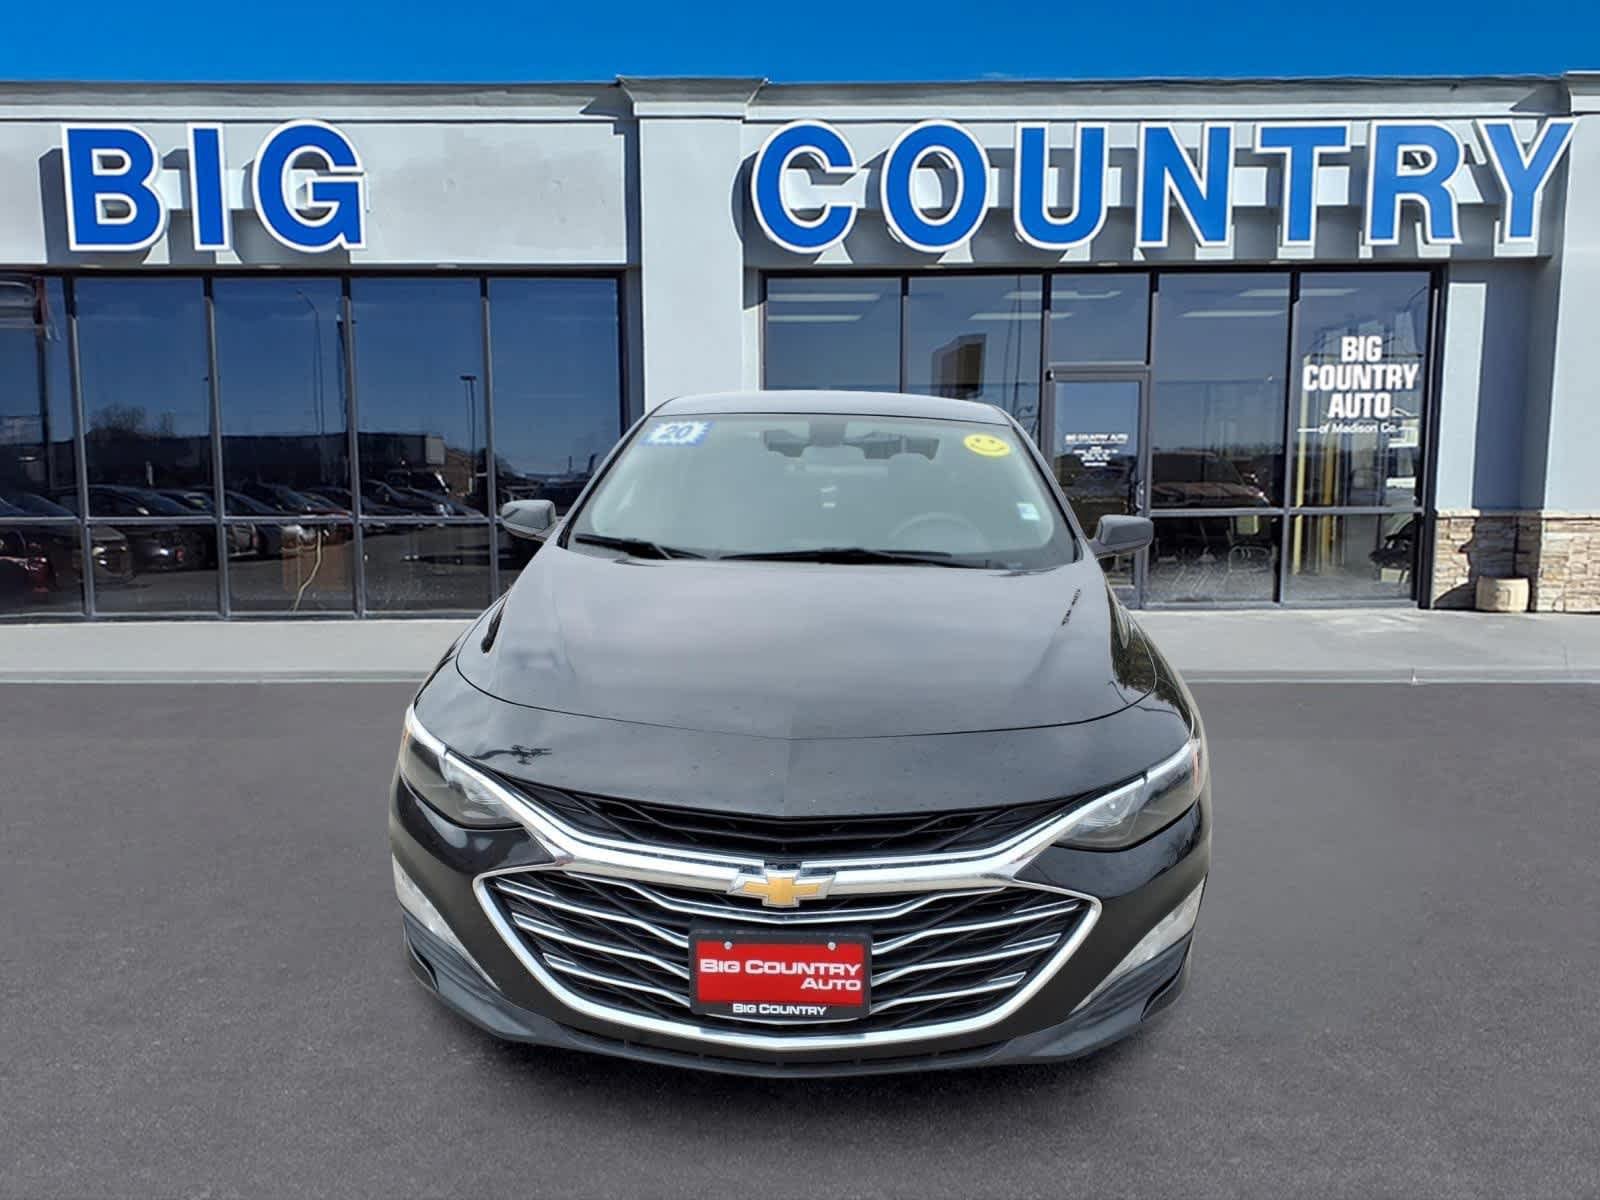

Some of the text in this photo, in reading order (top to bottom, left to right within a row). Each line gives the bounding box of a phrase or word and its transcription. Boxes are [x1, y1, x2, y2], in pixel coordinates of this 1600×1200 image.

[61, 117, 1575, 254] BIG COUNTRY
[1341, 335, 1382, 362] BIG
[1303, 363, 1419, 391] COUNTRY
[1327, 392, 1391, 419] AUTO
[657, 423, 696, 441] 20
[700, 958, 861, 977] BIG COUNTRY
[800, 977, 861, 991] AUTO
[732, 1003, 827, 1016] BIG COUNTRY
